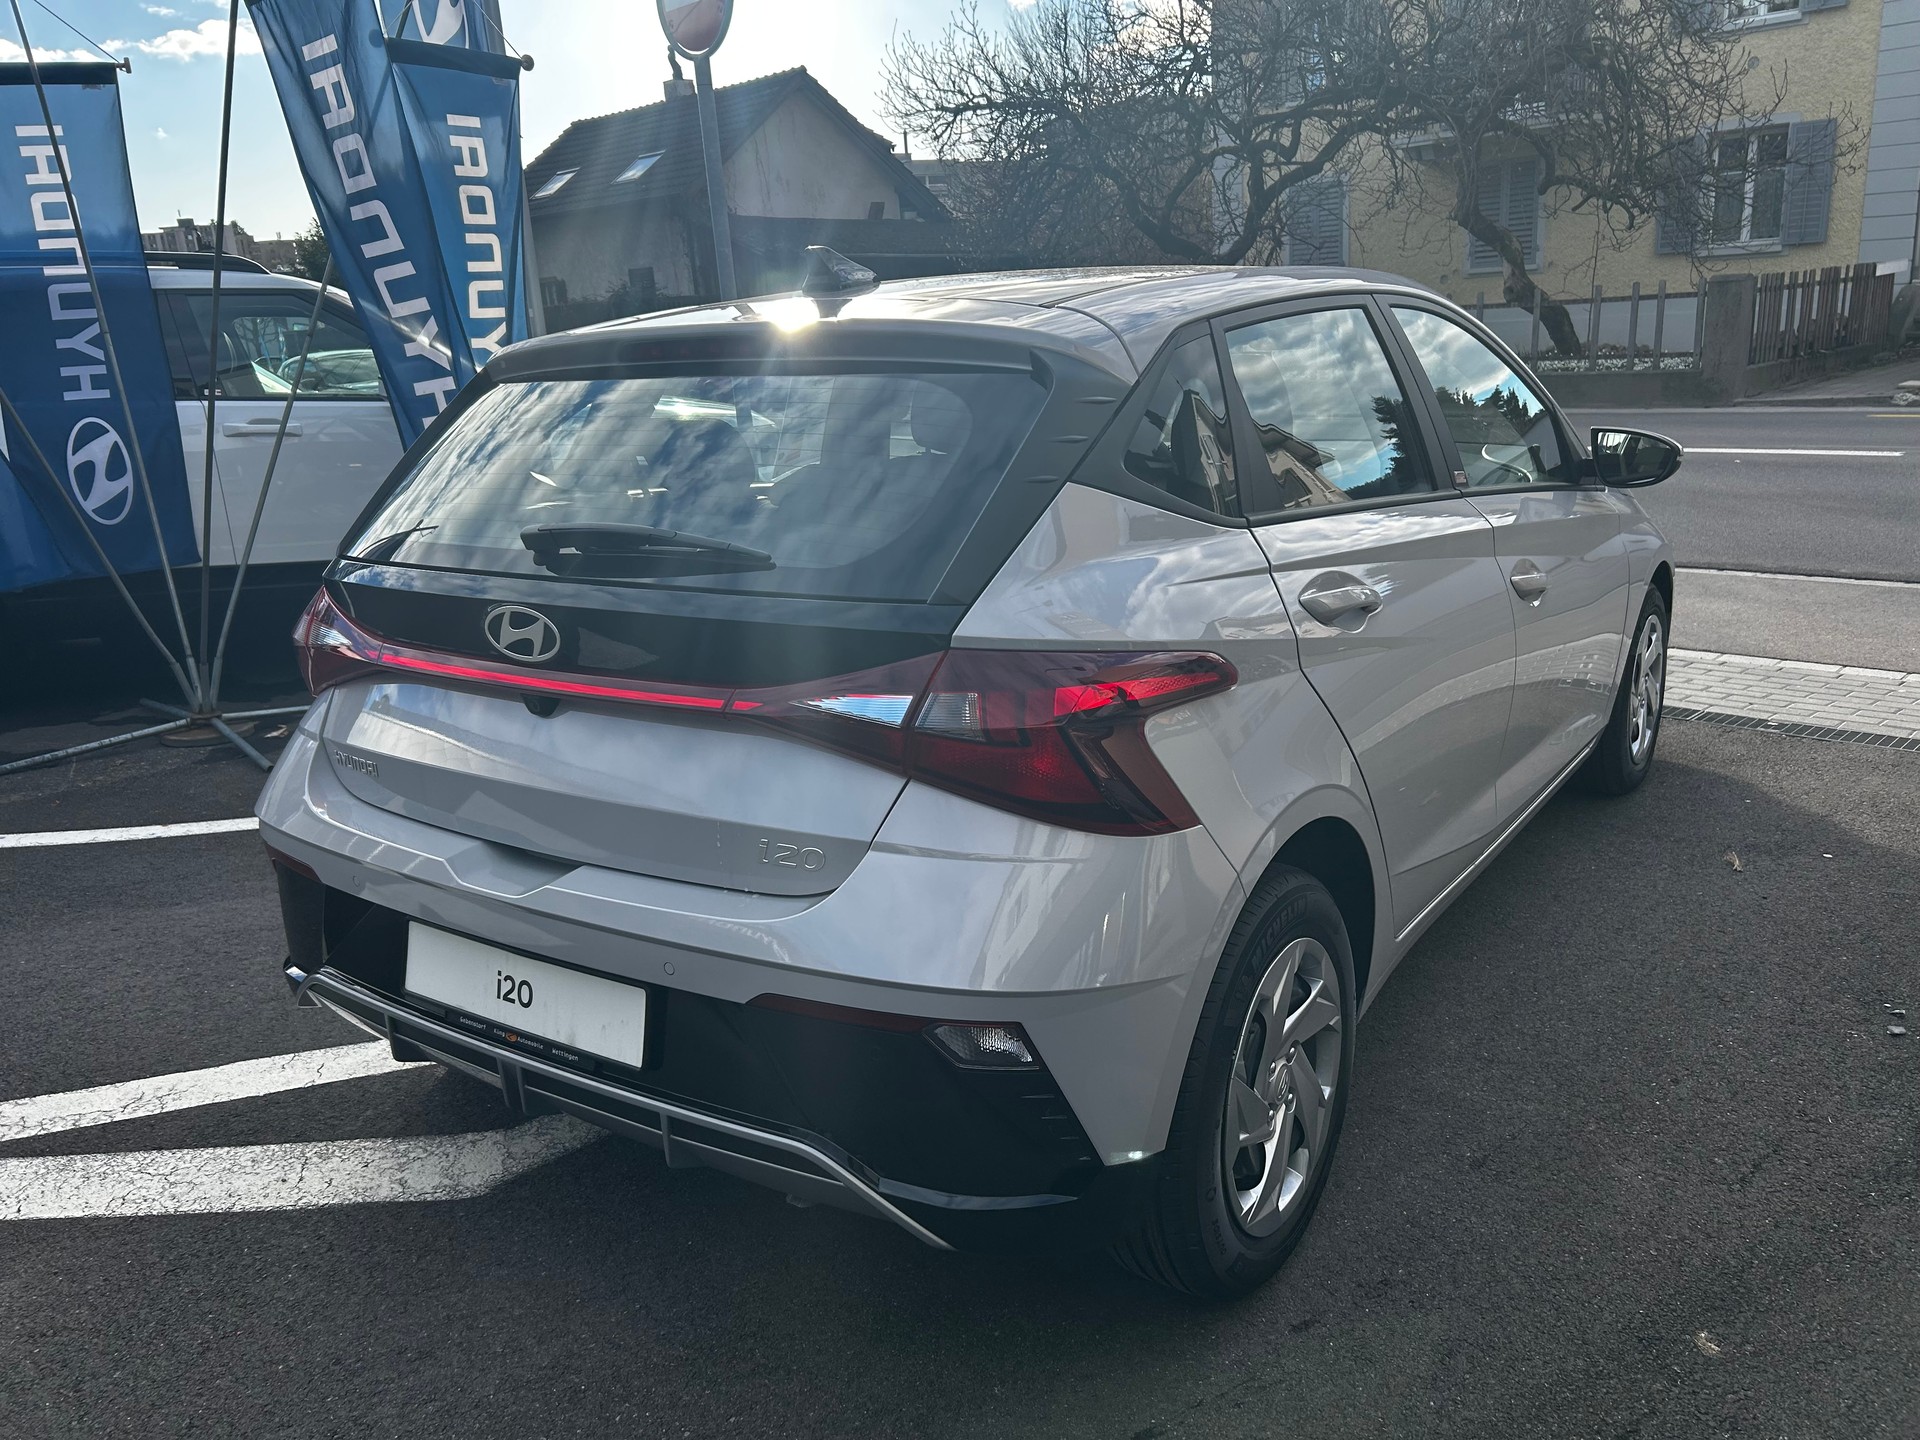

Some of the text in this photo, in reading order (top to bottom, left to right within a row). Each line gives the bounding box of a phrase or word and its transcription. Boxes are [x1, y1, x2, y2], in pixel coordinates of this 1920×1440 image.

[759, 838, 826, 872] i20
[497, 969, 534, 1008] i20
[517, 1036, 544, 1050] Automobile
[551, 1047, 579, 1061] Wettingen
